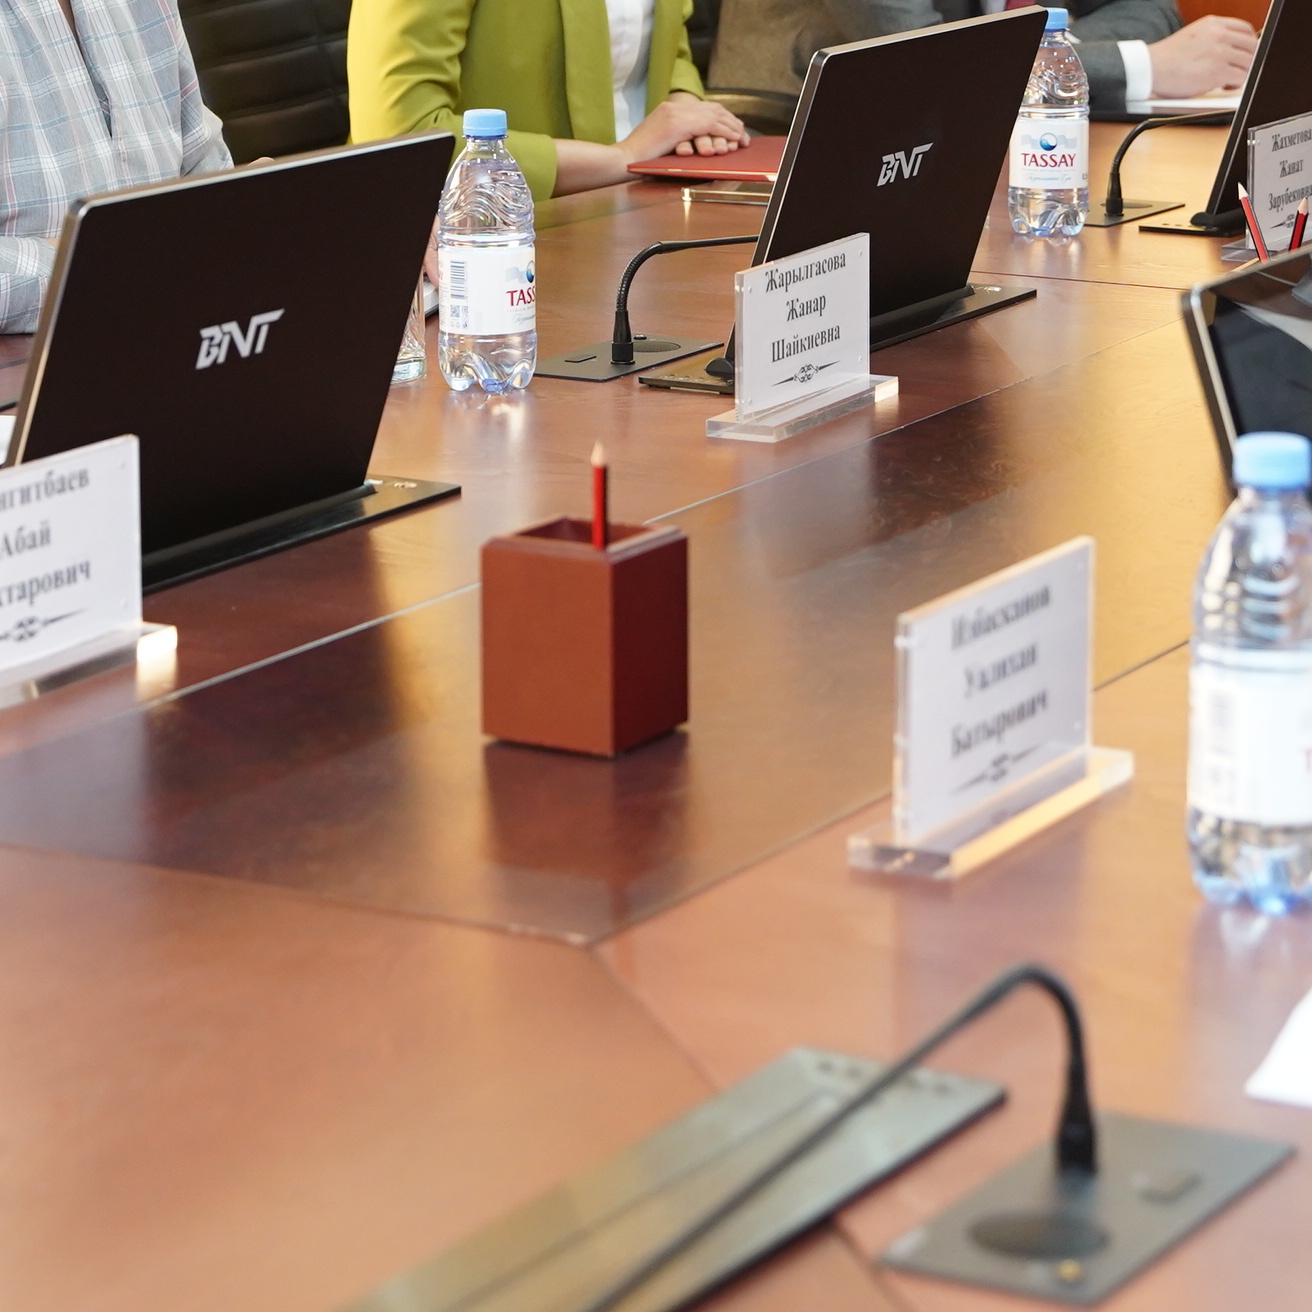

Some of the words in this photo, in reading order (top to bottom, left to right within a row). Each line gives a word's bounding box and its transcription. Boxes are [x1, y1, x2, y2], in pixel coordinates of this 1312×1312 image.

[1272, 129, 1312, 152] Жахметова
[877, 142, 934, 187] BNT
[1021, 153, 1076, 168] TASSAY
[1279, 159, 1304, 178] Жанат
[765, 252, 846, 293] Жарылгасова
[785, 294, 826, 323] Жанар
[195, 308, 285, 370] BNT
[771, 325, 841, 363] Шайкиевна
